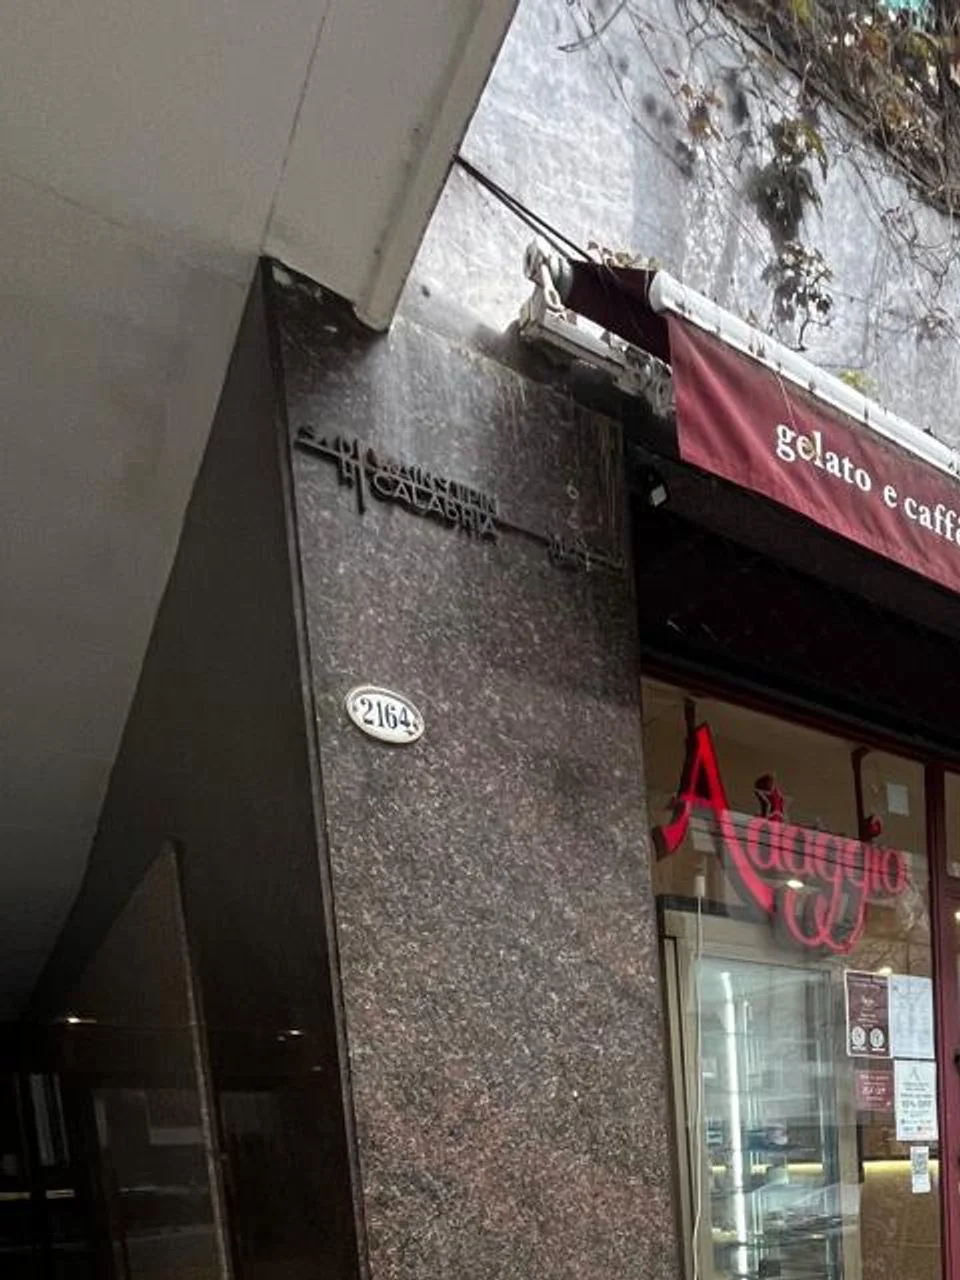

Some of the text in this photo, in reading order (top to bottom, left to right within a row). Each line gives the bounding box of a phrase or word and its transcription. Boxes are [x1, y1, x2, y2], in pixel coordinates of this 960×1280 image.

[372, 470, 499, 538] CALABRIA
[775, 423, 872, 493] gelato
[883, 484, 898, 509] e
[358, 696, 411, 729] 2164
[652, 721, 910, 957] Adaggio
